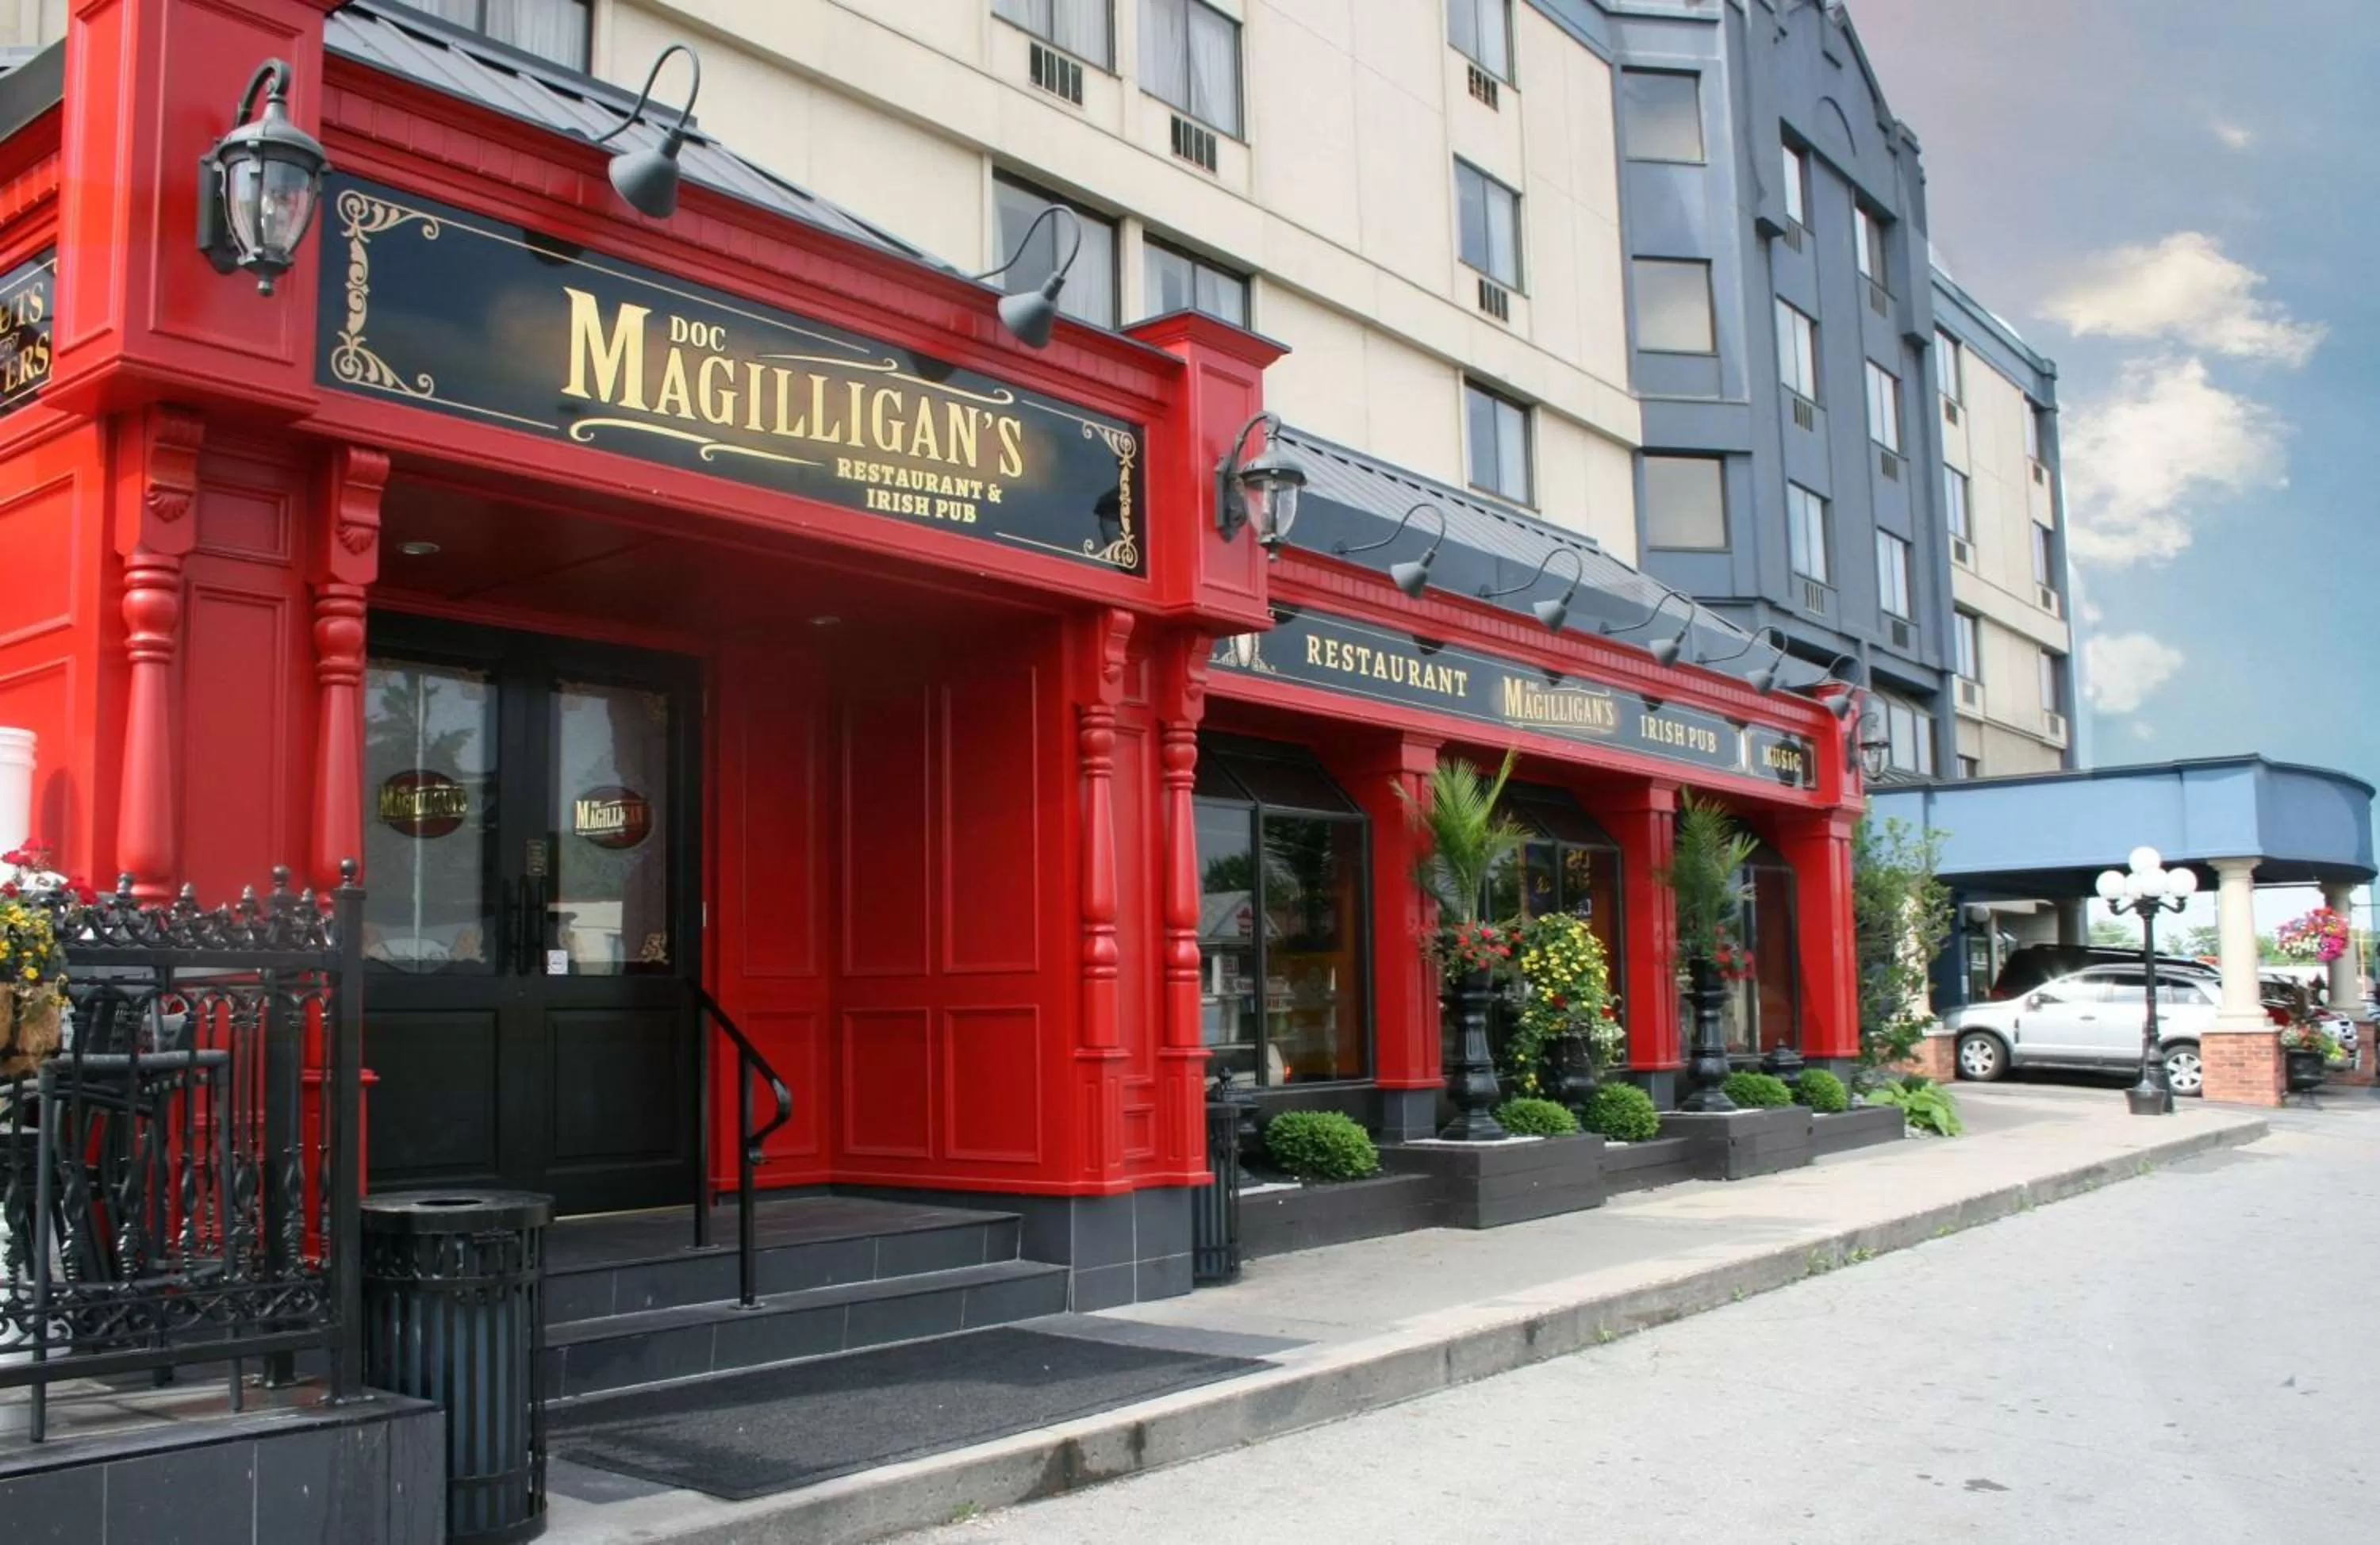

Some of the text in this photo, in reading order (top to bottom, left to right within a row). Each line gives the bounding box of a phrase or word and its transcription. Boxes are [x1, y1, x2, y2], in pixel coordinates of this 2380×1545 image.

[670, 315, 726, 352] DOC
[561, 286, 1023, 477] MAGILLIGAN'S
[837, 458, 1003, 504] RESTAURANT &
[866, 488, 977, 523] IRISH PUB
[1307, 634, 1467, 697] RESTAURANT
[1503, 676, 1614, 726] MAGILLIGAN'S
[1641, 715, 1716, 753] IRISH PUB
